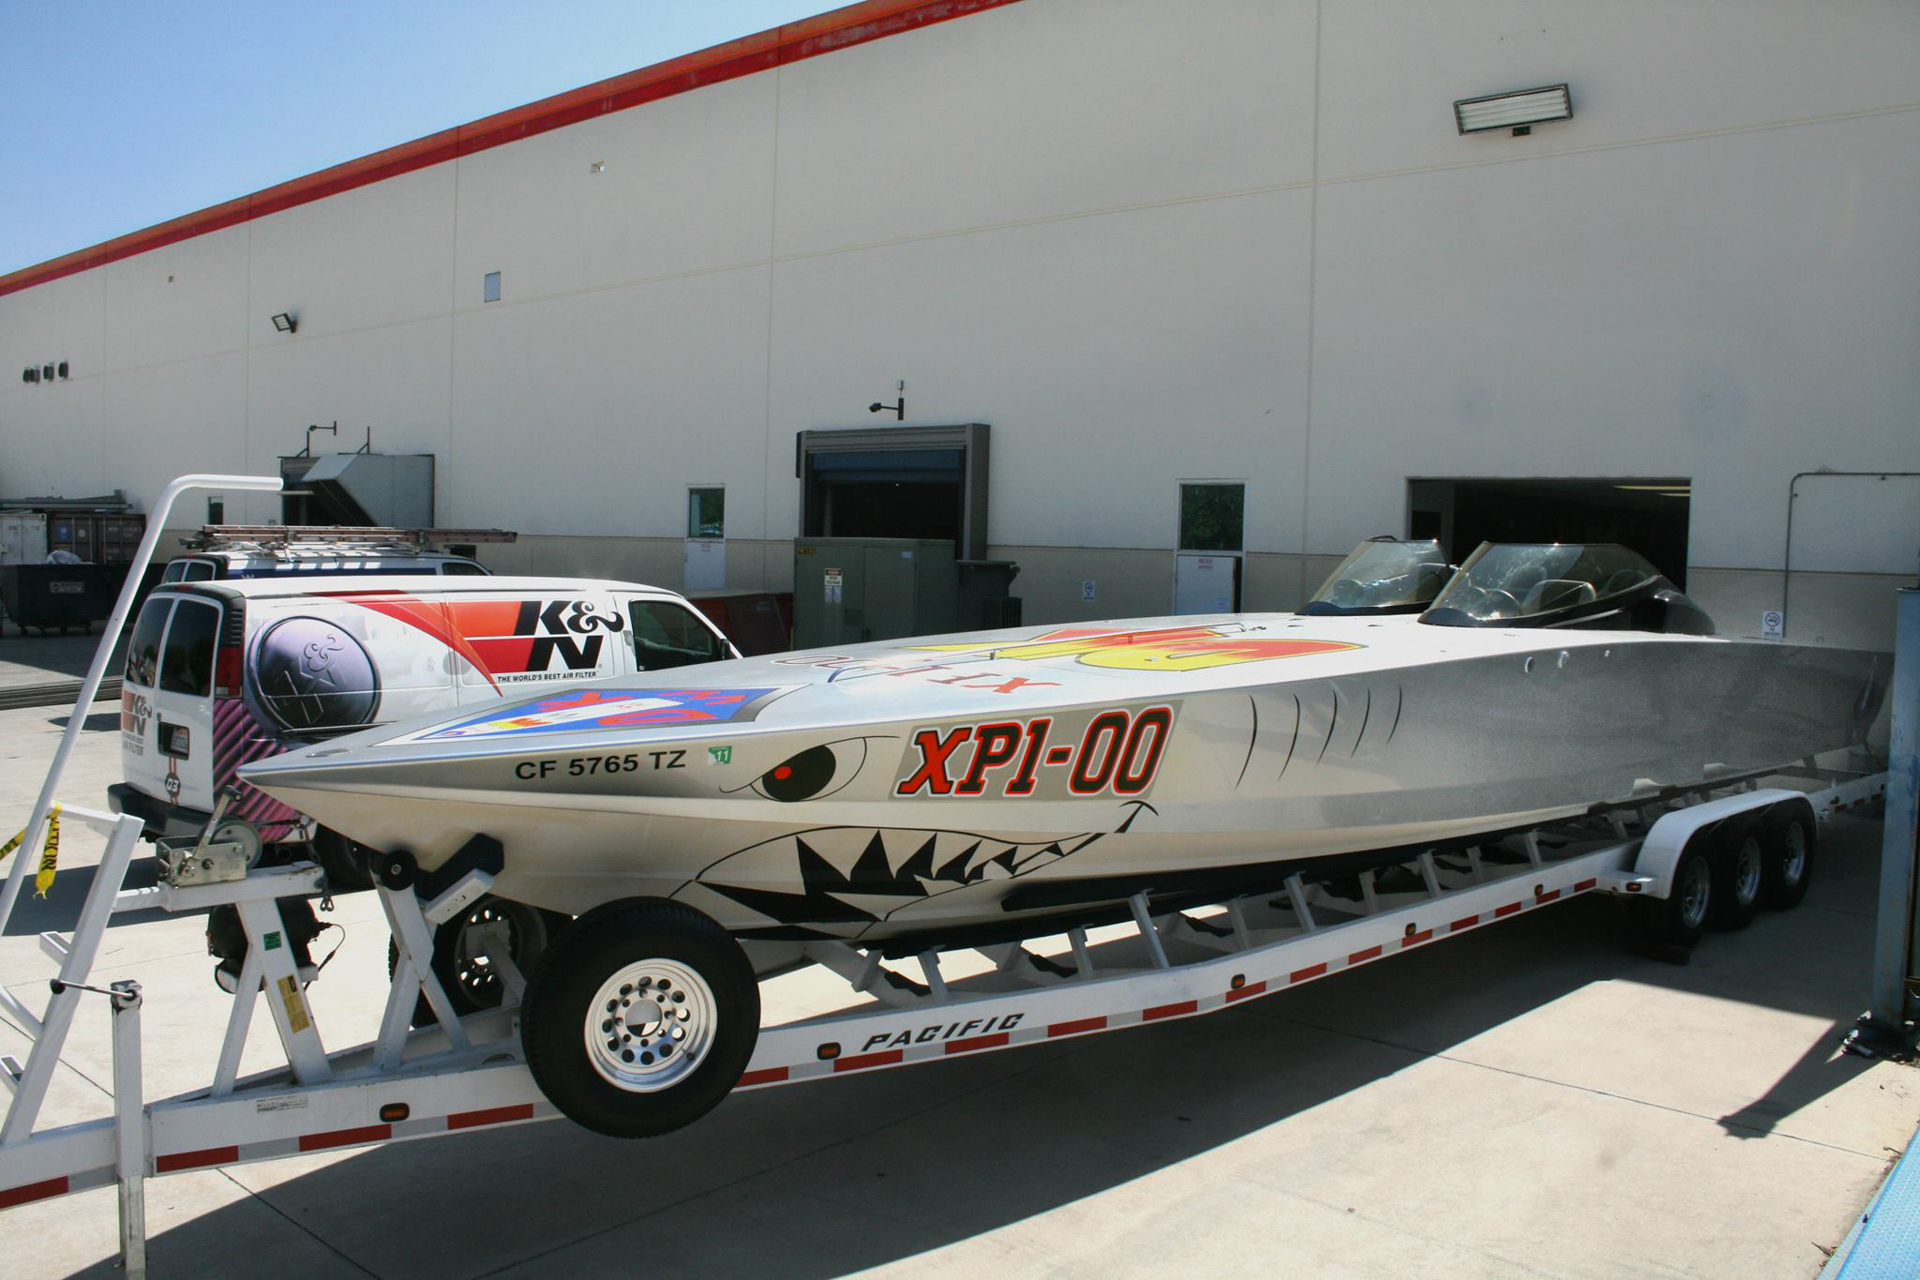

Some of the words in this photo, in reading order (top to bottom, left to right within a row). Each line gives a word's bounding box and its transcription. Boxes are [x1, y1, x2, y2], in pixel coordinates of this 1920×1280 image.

[512, 674, 543, 682] WORLD'S
[716, 749, 729, 762] 11
[896, 706, 1174, 796] XP1-00
[515, 760, 557, 779] CF
[569, 754, 639, 776] 5765
[649, 750, 687, 770] TZ
[166, 778, 179, 792] 03
[861, 1012, 1025, 1052] PACIFIC
